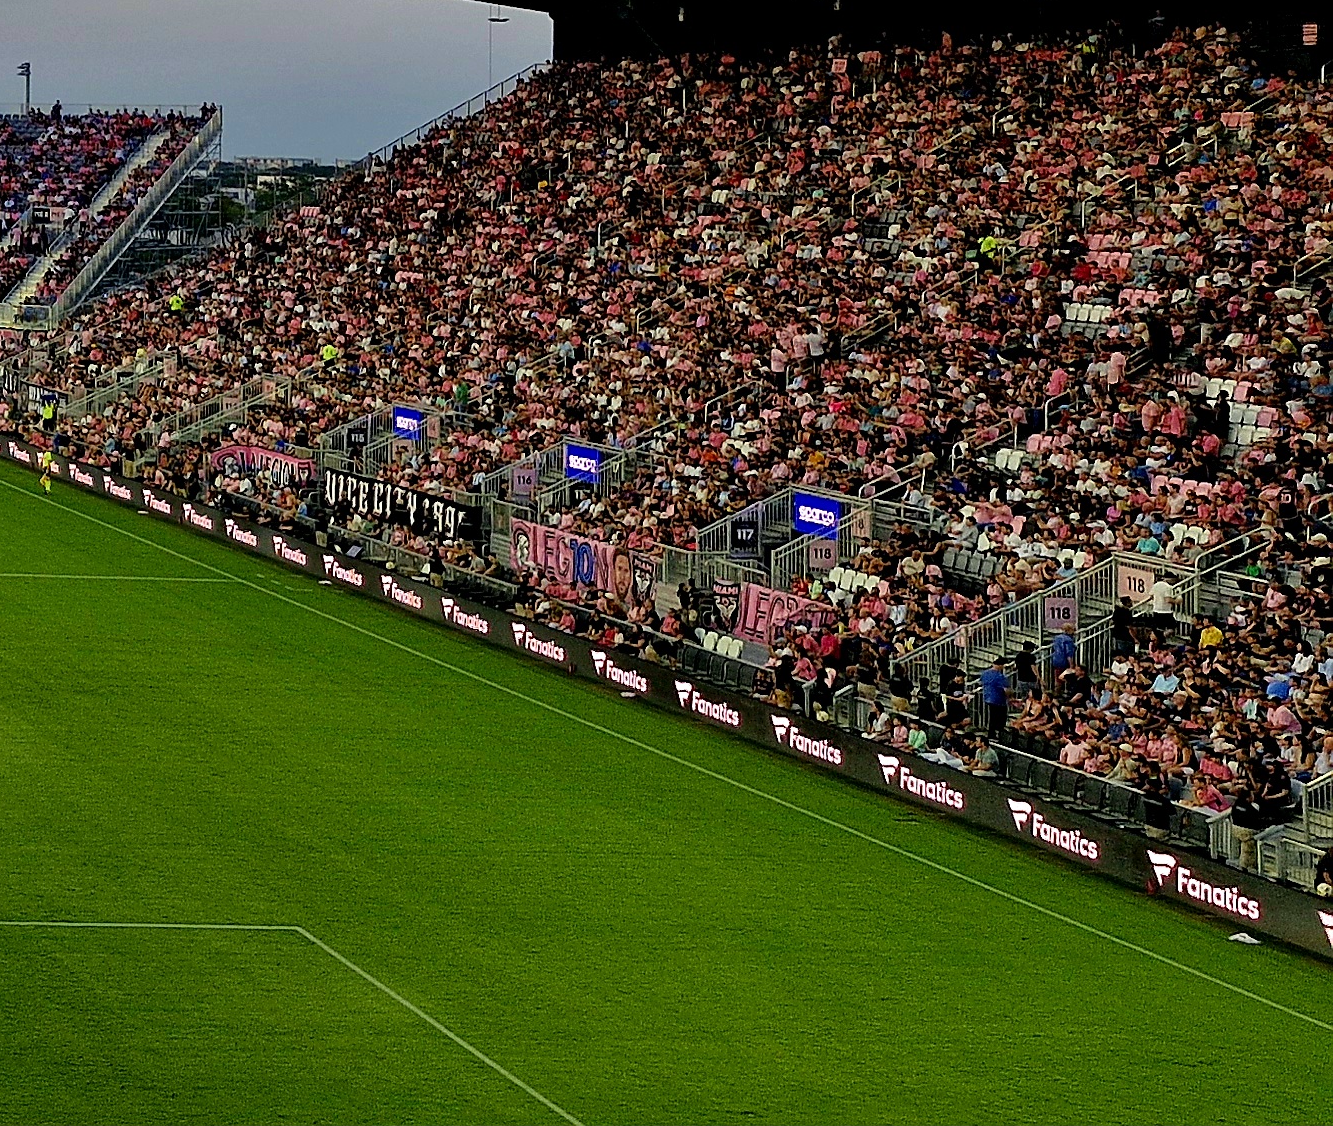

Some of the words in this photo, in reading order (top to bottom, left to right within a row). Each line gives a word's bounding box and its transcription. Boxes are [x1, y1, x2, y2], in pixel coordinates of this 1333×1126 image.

[325, 469, 369, 515] VICE
[517, 475, 532, 485] 116
[798, 505, 835, 524] sparco
[736, 529, 754, 540] 117
[813, 548, 832, 560] 118
[1127, 576, 1145, 594] 118
[453, 605, 489, 634] Fanatics
[1049, 606, 1071, 620] 118
[525, 631, 565, 662] Fanatics
[605, 660, 648, 693] Fanatics
[691, 692, 741, 726] Fanatics
[789, 726, 843, 766] Fanatics
[899, 766, 965, 810] Fanatics
[1032, 813, 1099, 860] Fanatics
[1176, 866, 1261, 920] Fanatics
